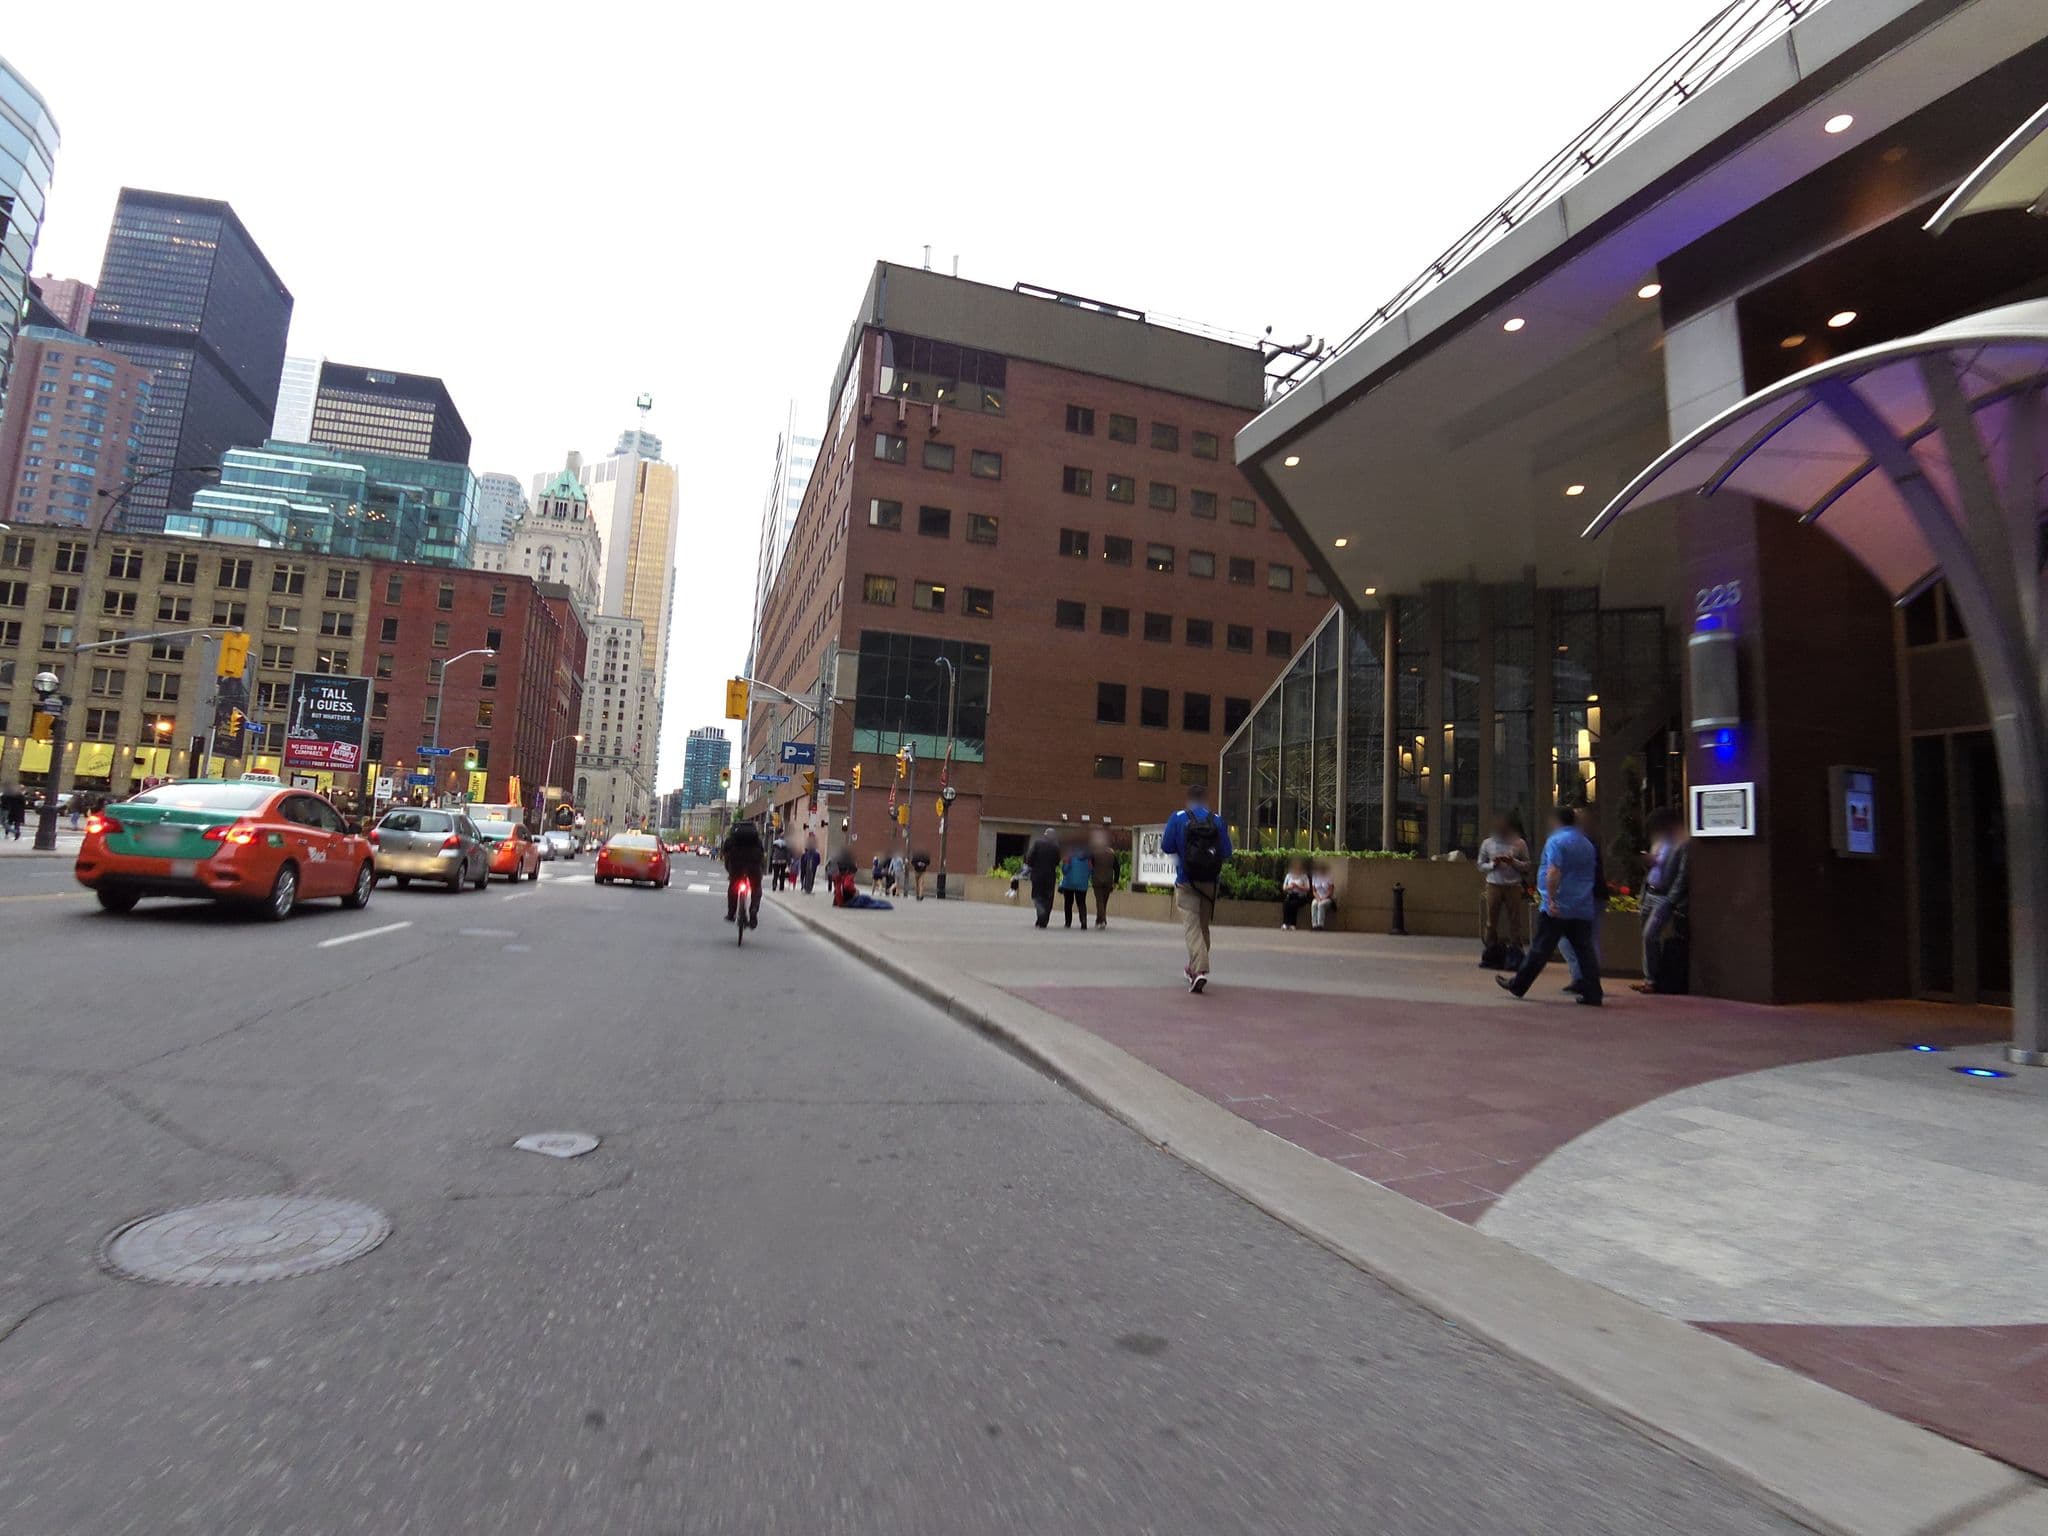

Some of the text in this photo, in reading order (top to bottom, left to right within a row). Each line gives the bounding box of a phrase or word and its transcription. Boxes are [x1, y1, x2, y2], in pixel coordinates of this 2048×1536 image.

[1696, 580, 1742, 613] 225
[321, 687, 348, 700] TALL
[310, 699, 356, 713] I GUESS.
[784, 746, 797, 760] P
